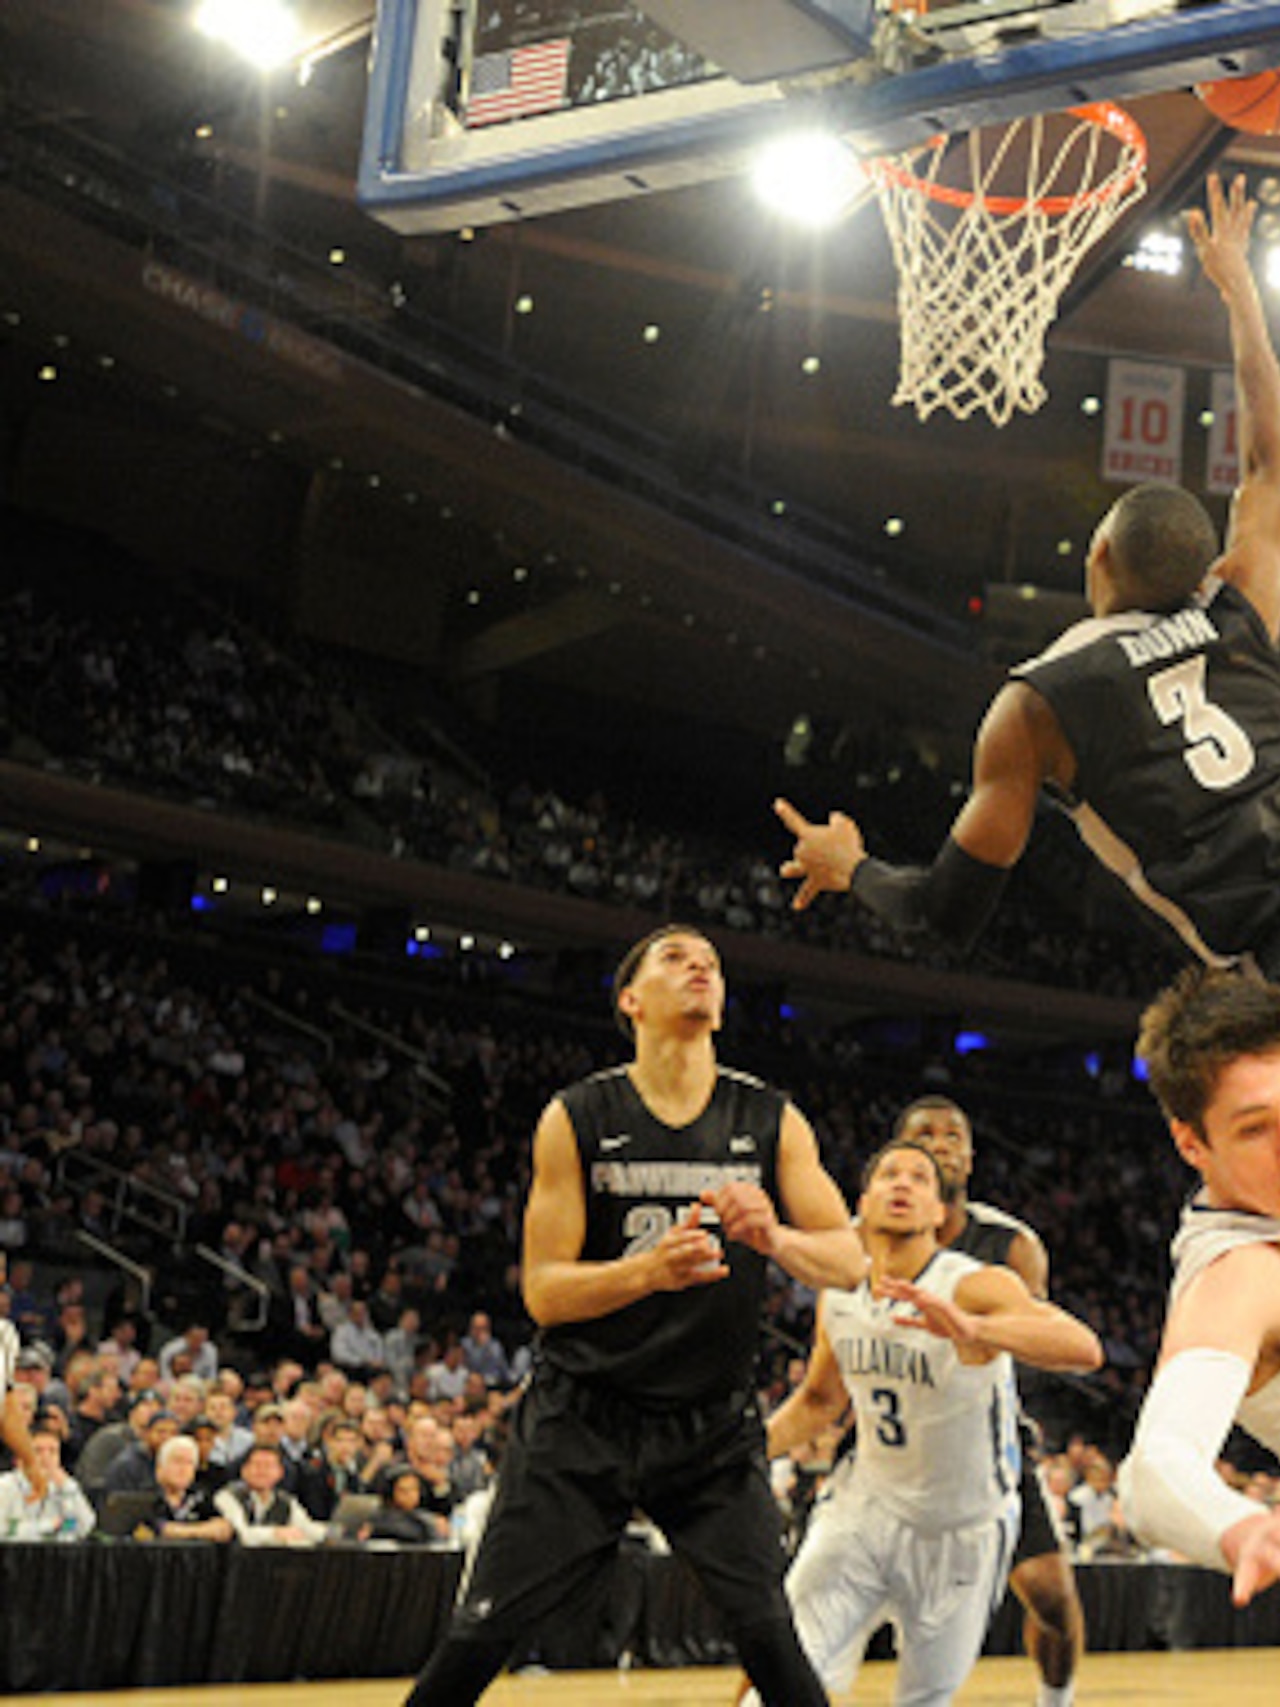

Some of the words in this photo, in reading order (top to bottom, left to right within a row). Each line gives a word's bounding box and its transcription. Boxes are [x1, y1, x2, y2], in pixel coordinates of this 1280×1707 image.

[1119, 397, 1169, 445] 10
[1116, 608, 1220, 667] DUNN
[1147, 654, 1255, 789] 3
[871, 1386, 908, 1448] 3
